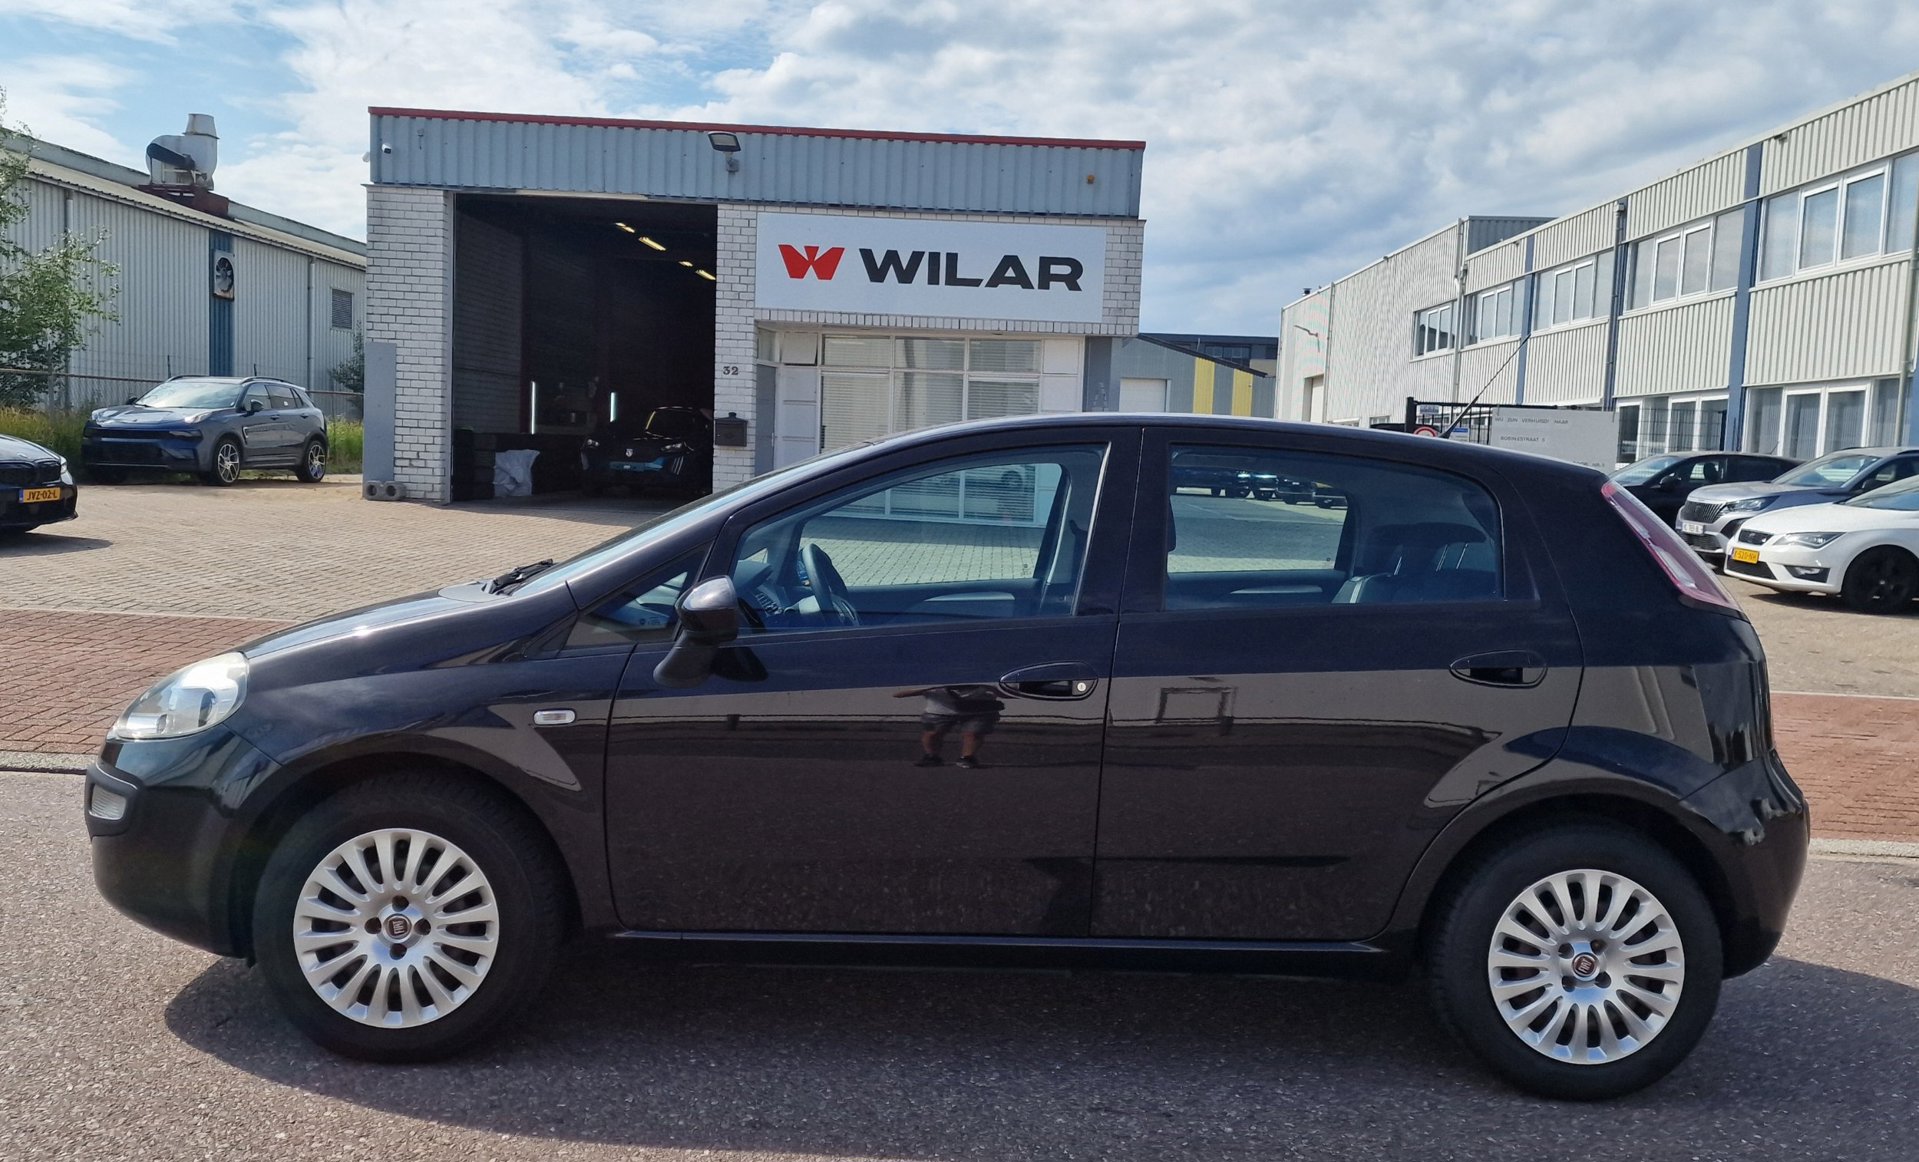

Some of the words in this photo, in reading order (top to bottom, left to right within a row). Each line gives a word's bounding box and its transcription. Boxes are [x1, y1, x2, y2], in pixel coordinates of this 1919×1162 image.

[859, 248, 1084, 292] WILAR
[723, 366, 739, 376] 32
[392, 920, 405, 935] FIAT
[1577, 957, 1592, 974] FIAT
